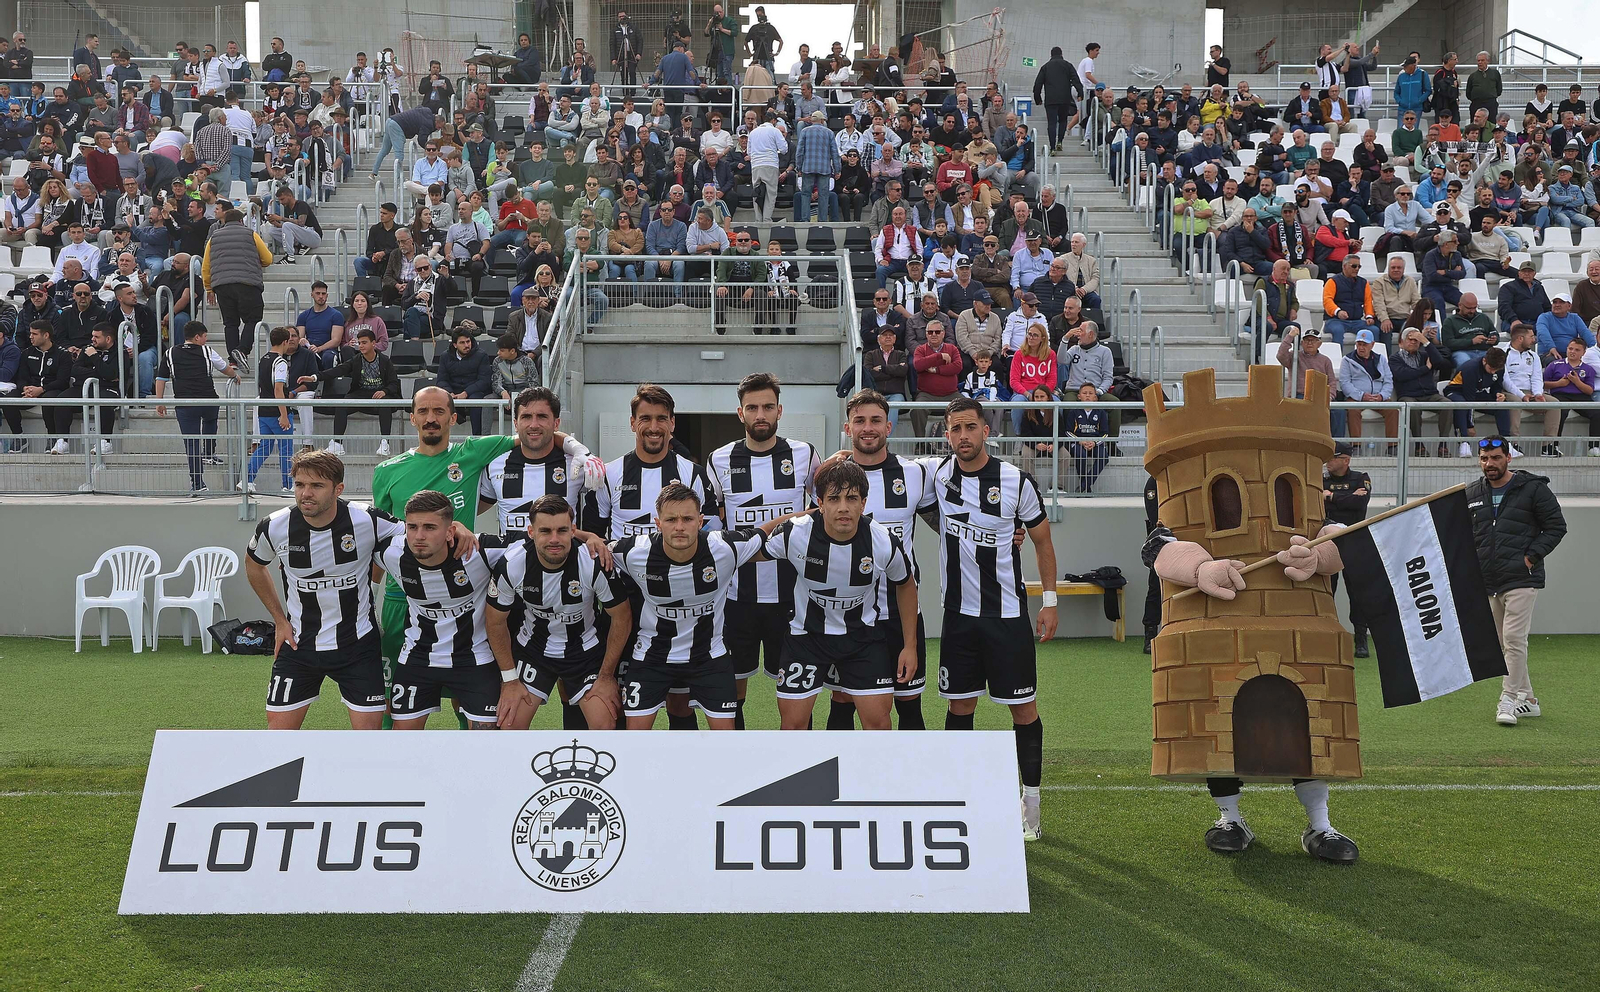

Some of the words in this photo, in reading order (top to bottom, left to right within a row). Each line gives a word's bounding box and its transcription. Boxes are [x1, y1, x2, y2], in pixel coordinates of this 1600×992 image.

[296, 575, 357, 591] LOTUS
[656, 600, 715, 619] LOTUS
[1405, 555, 1443, 641] BALONA
[270, 674, 294, 703] 11
[785, 662, 818, 690] 23
[939, 665, 950, 691] 8
[391, 683, 418, 710] 21
[516, 809, 538, 845] REAL
[537, 785, 621, 841] BALOMPEDICA
[158, 821, 423, 873] LOTUS
[715, 820, 971, 871] LOTUS
[537, 868, 600, 888] LINENSE
